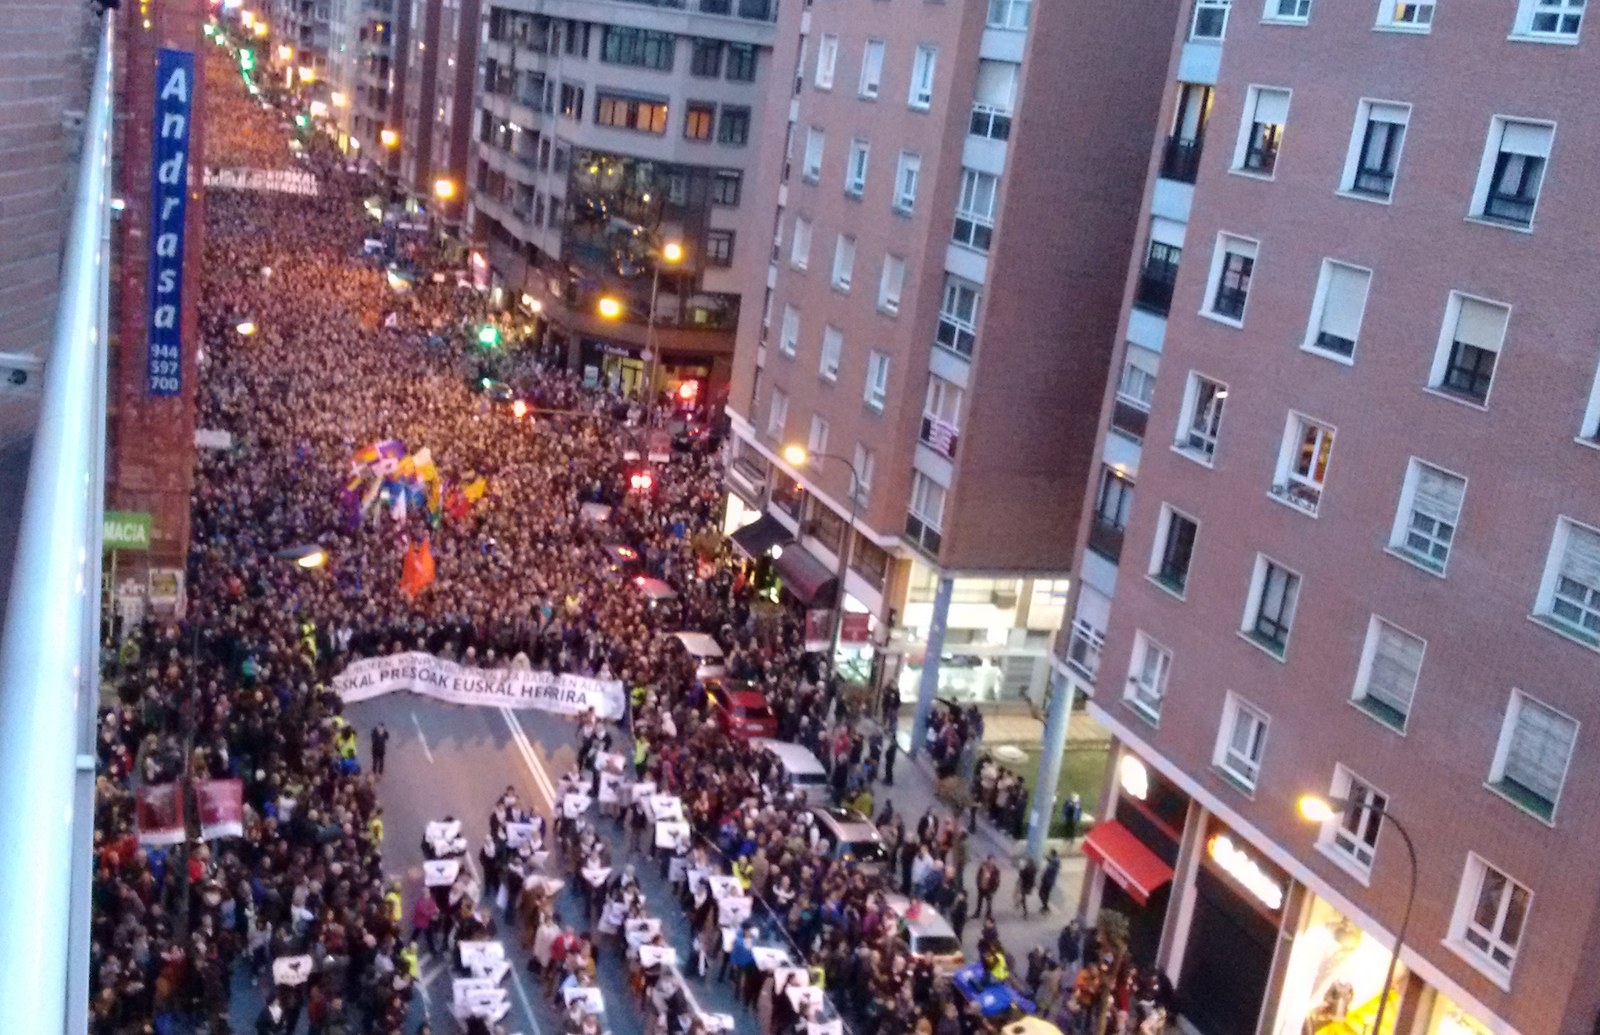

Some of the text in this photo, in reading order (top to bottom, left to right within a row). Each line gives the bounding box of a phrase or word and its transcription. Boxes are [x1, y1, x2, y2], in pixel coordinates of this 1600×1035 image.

[154, 67, 187, 329] Andrasa
[151, 360, 178, 375] 597
[151, 376, 178, 390] 700
[381, 667, 448, 687] PRESOAK
[453, 678, 515, 695] EUSKAL
[521, 685, 587, 705] HERRIRA
